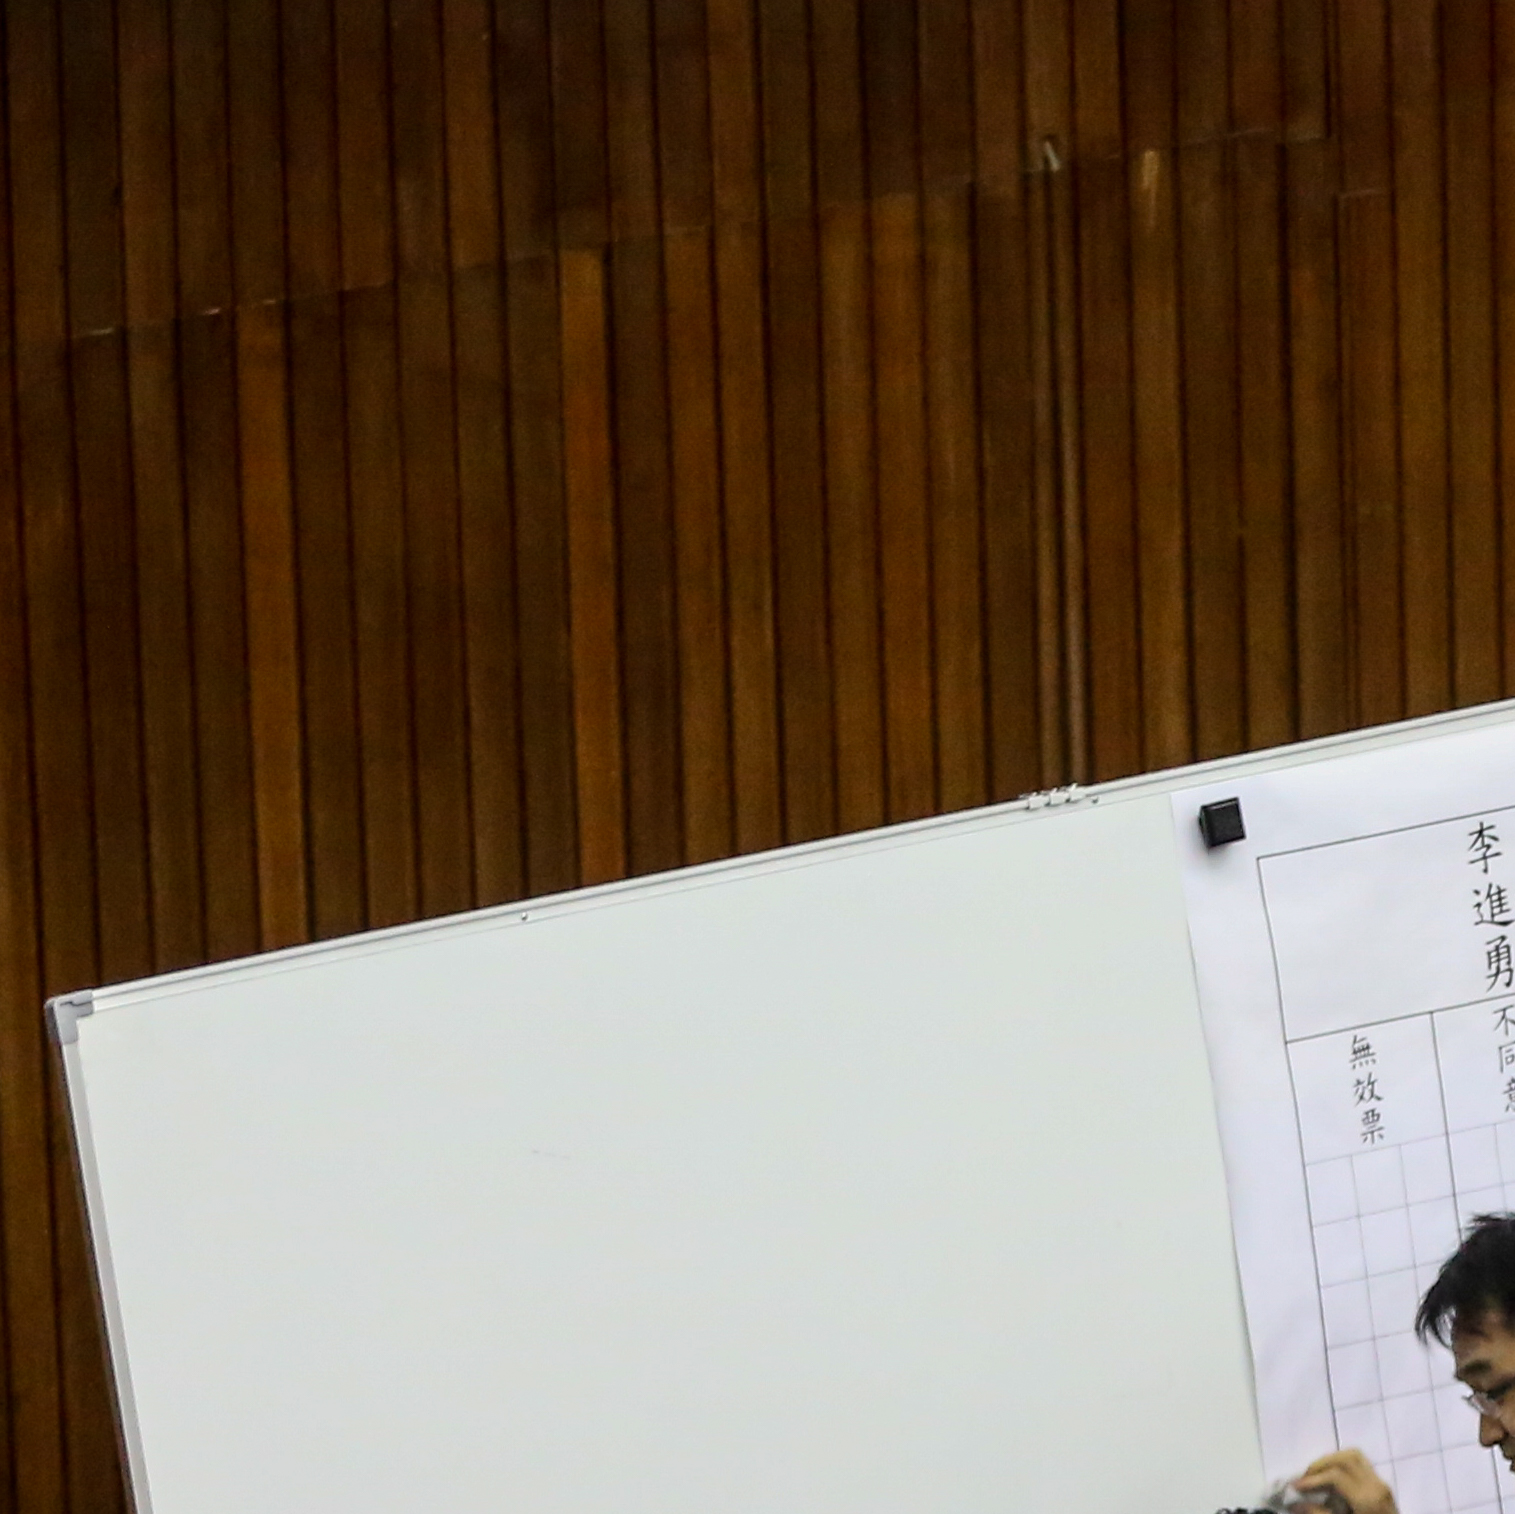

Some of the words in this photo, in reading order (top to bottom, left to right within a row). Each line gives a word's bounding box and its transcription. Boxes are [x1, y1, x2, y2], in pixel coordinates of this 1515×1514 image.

[1468, 821, 1515, 992] 李進勇
[1350, 1035, 1385, 1145] 無效票
